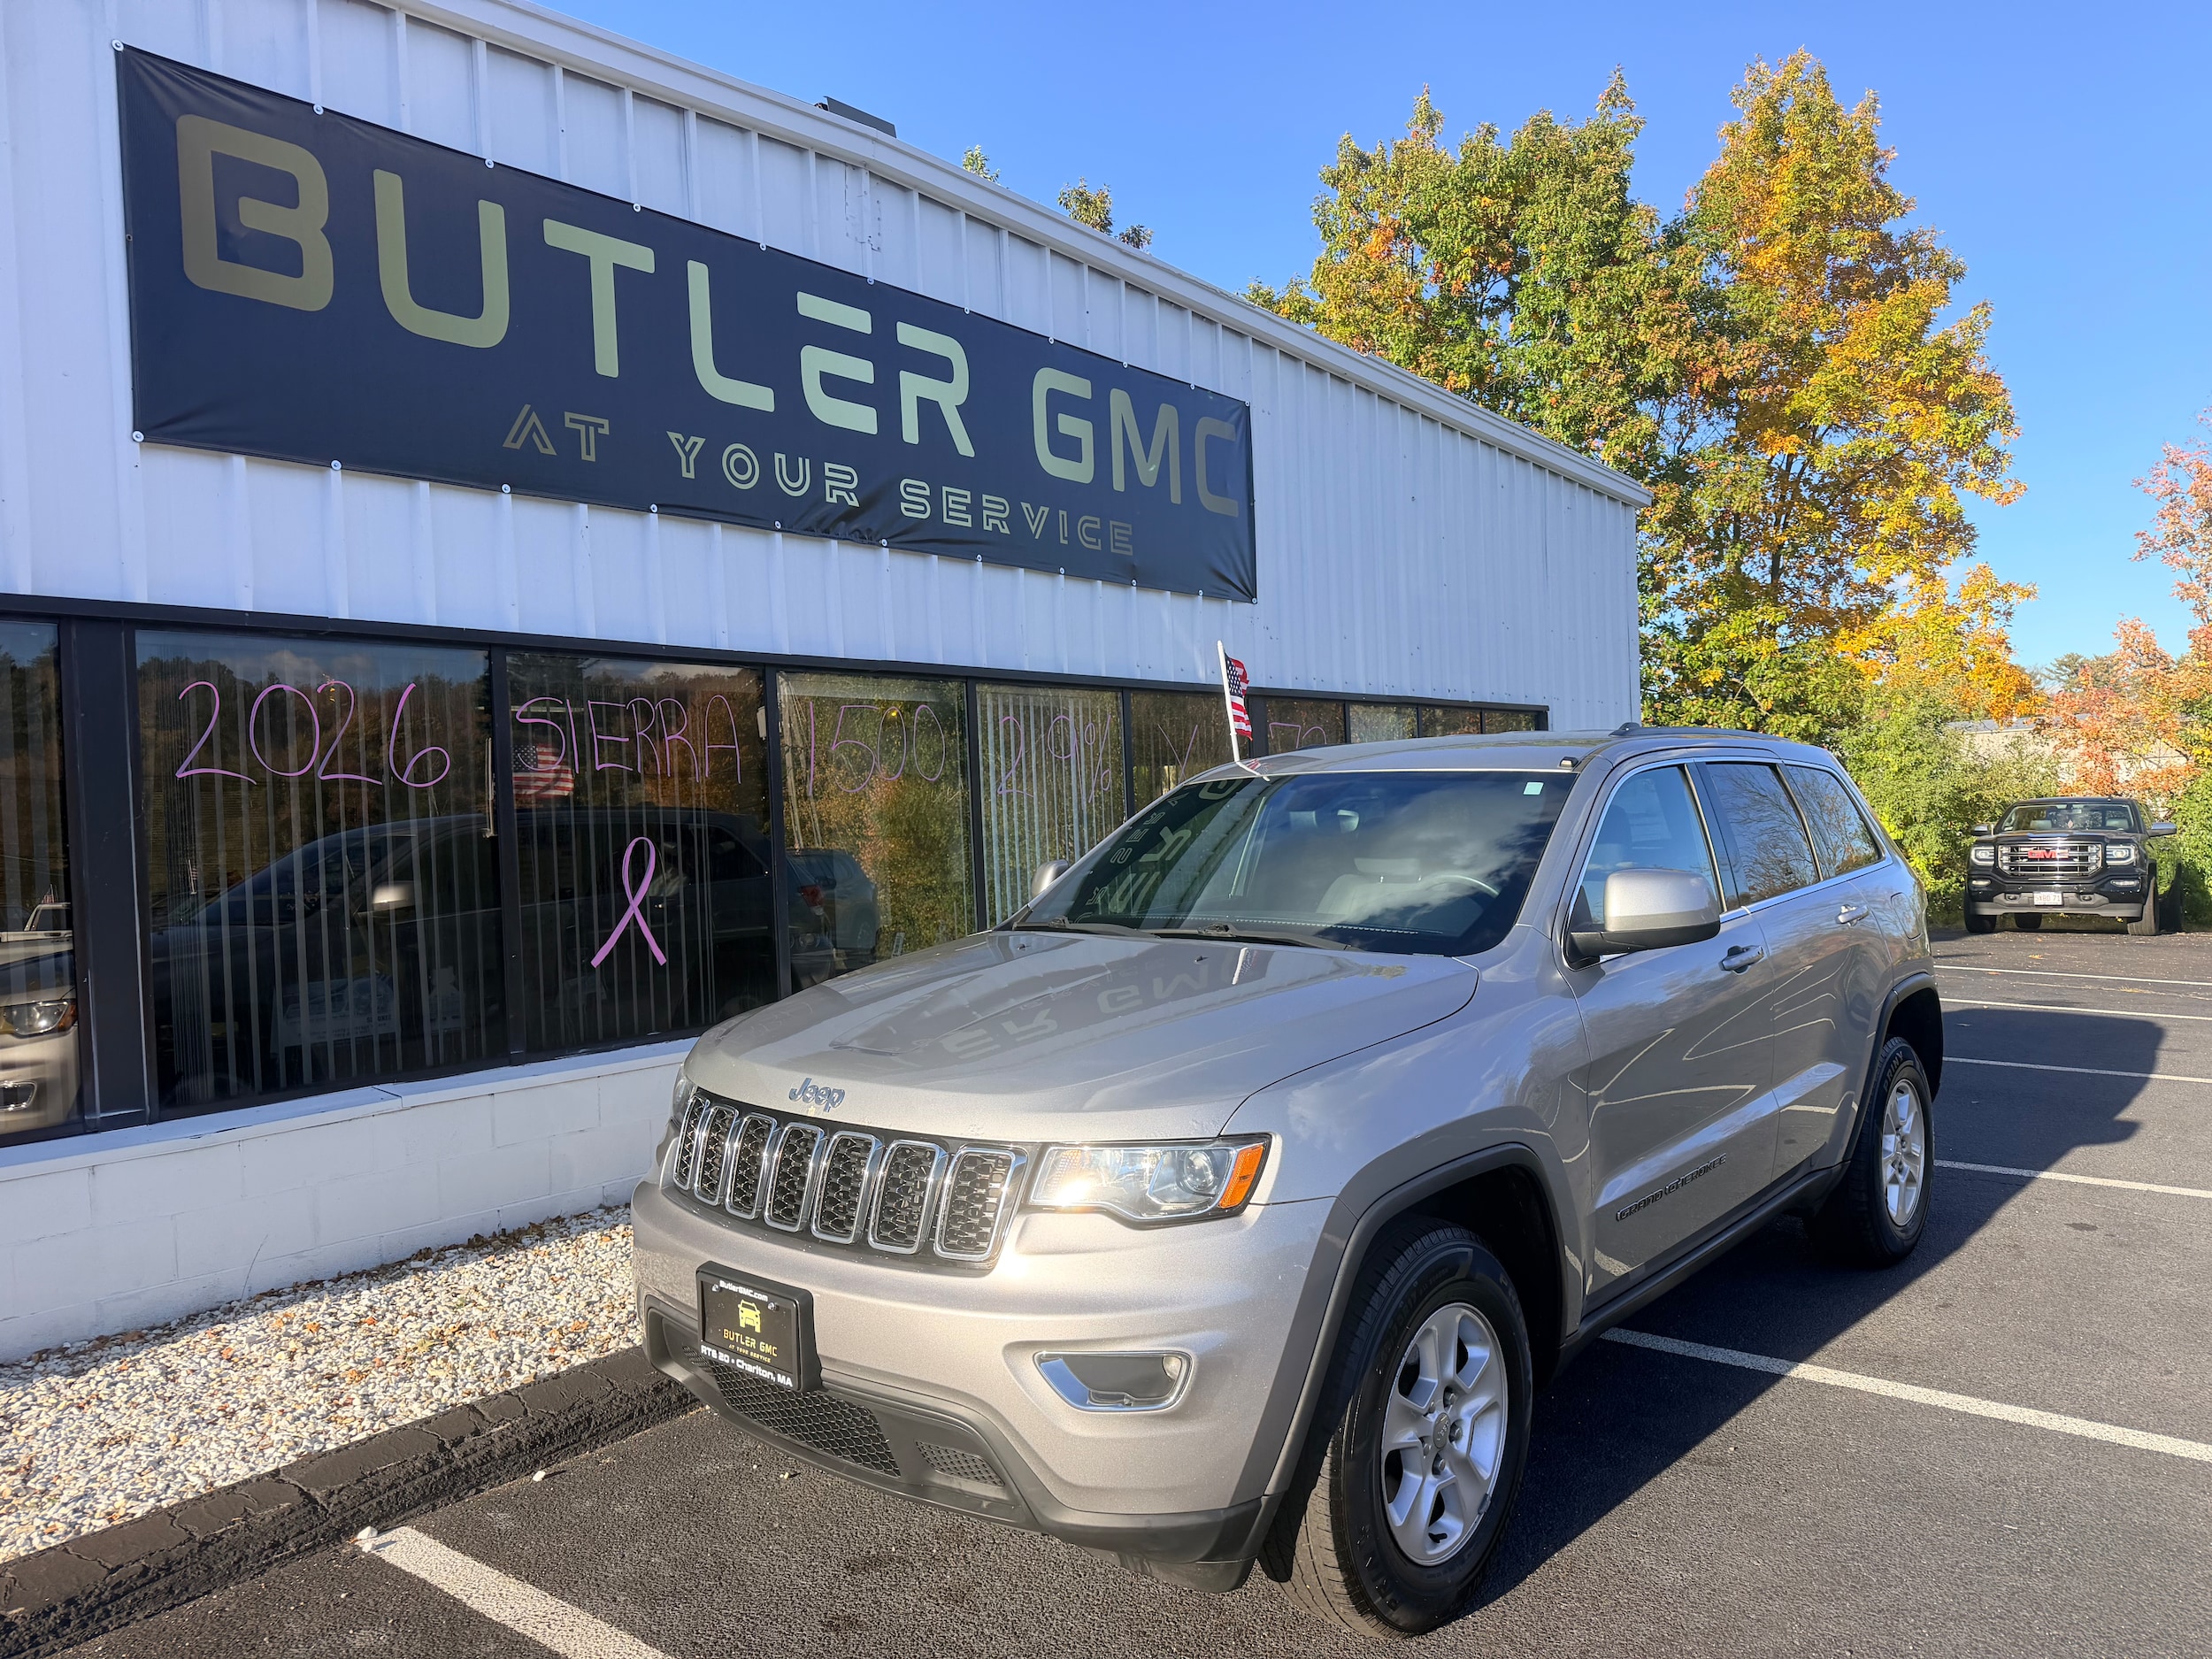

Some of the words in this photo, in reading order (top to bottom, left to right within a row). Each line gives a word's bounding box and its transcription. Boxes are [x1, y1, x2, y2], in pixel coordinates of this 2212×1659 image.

[176, 114, 975, 457] BUTLER
[1032, 366, 1238, 517] GMC
[503, 404, 610, 462] AT
[666, 431, 860, 507] YOUR
[899, 479, 1133, 557] SERVICE
[176, 680, 450, 788] 2026
[516, 695, 741, 784] SIERRA
[809, 702, 946, 796] 1500
[2027, 849, 2069, 859] GMC
[788, 1077, 846, 1113] Jeep
[1617, 1188, 1663, 1221] GRAND
[1664, 1152, 1727, 1195] CHEROKEE
[719, 1279, 769, 1302] ButlerGMC.com
[723, 1328, 757, 1349] BUTLER
[759, 1341, 778, 1357] GMC
[718, 1354, 730, 1363] 20
[777, 1373, 793, 1387] MA
